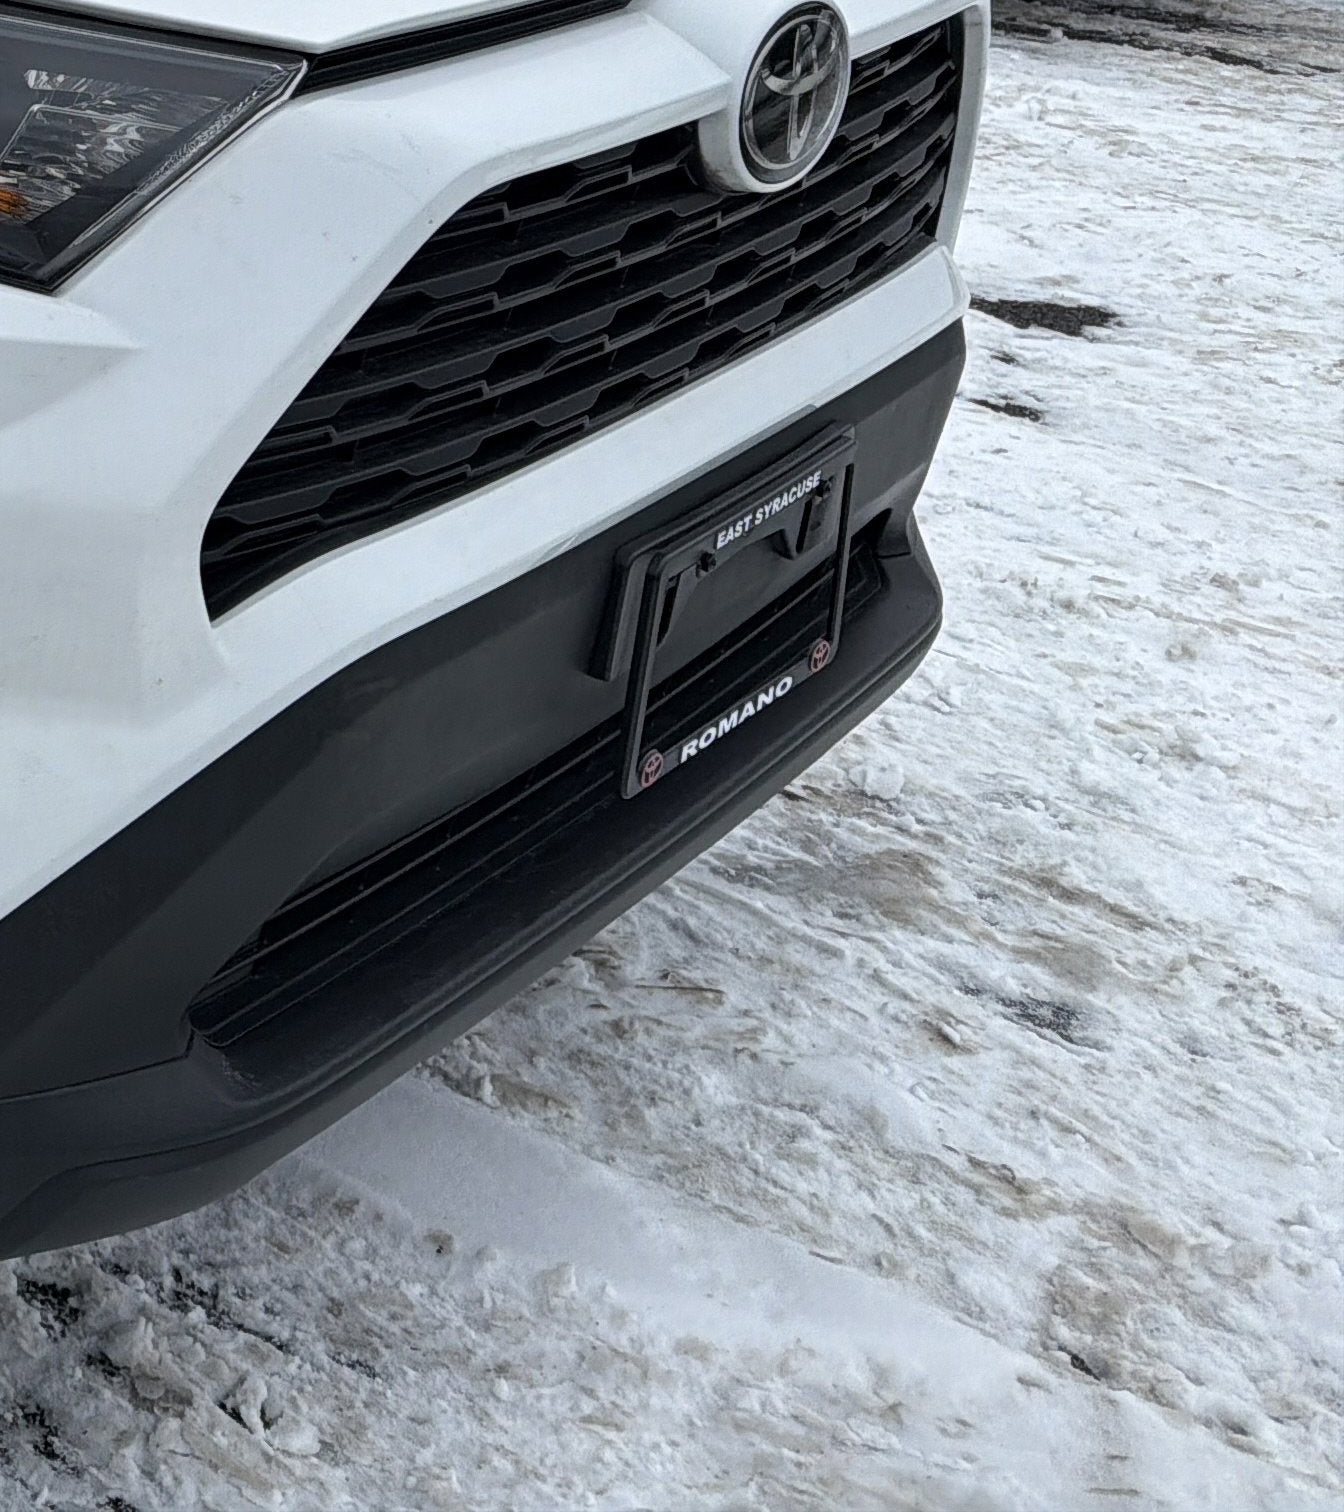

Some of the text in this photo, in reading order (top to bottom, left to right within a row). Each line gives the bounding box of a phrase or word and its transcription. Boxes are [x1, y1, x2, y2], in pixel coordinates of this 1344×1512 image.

[716, 469, 822, 550] EAST SYRACUSE
[680, 676, 793, 764] ROMANO
